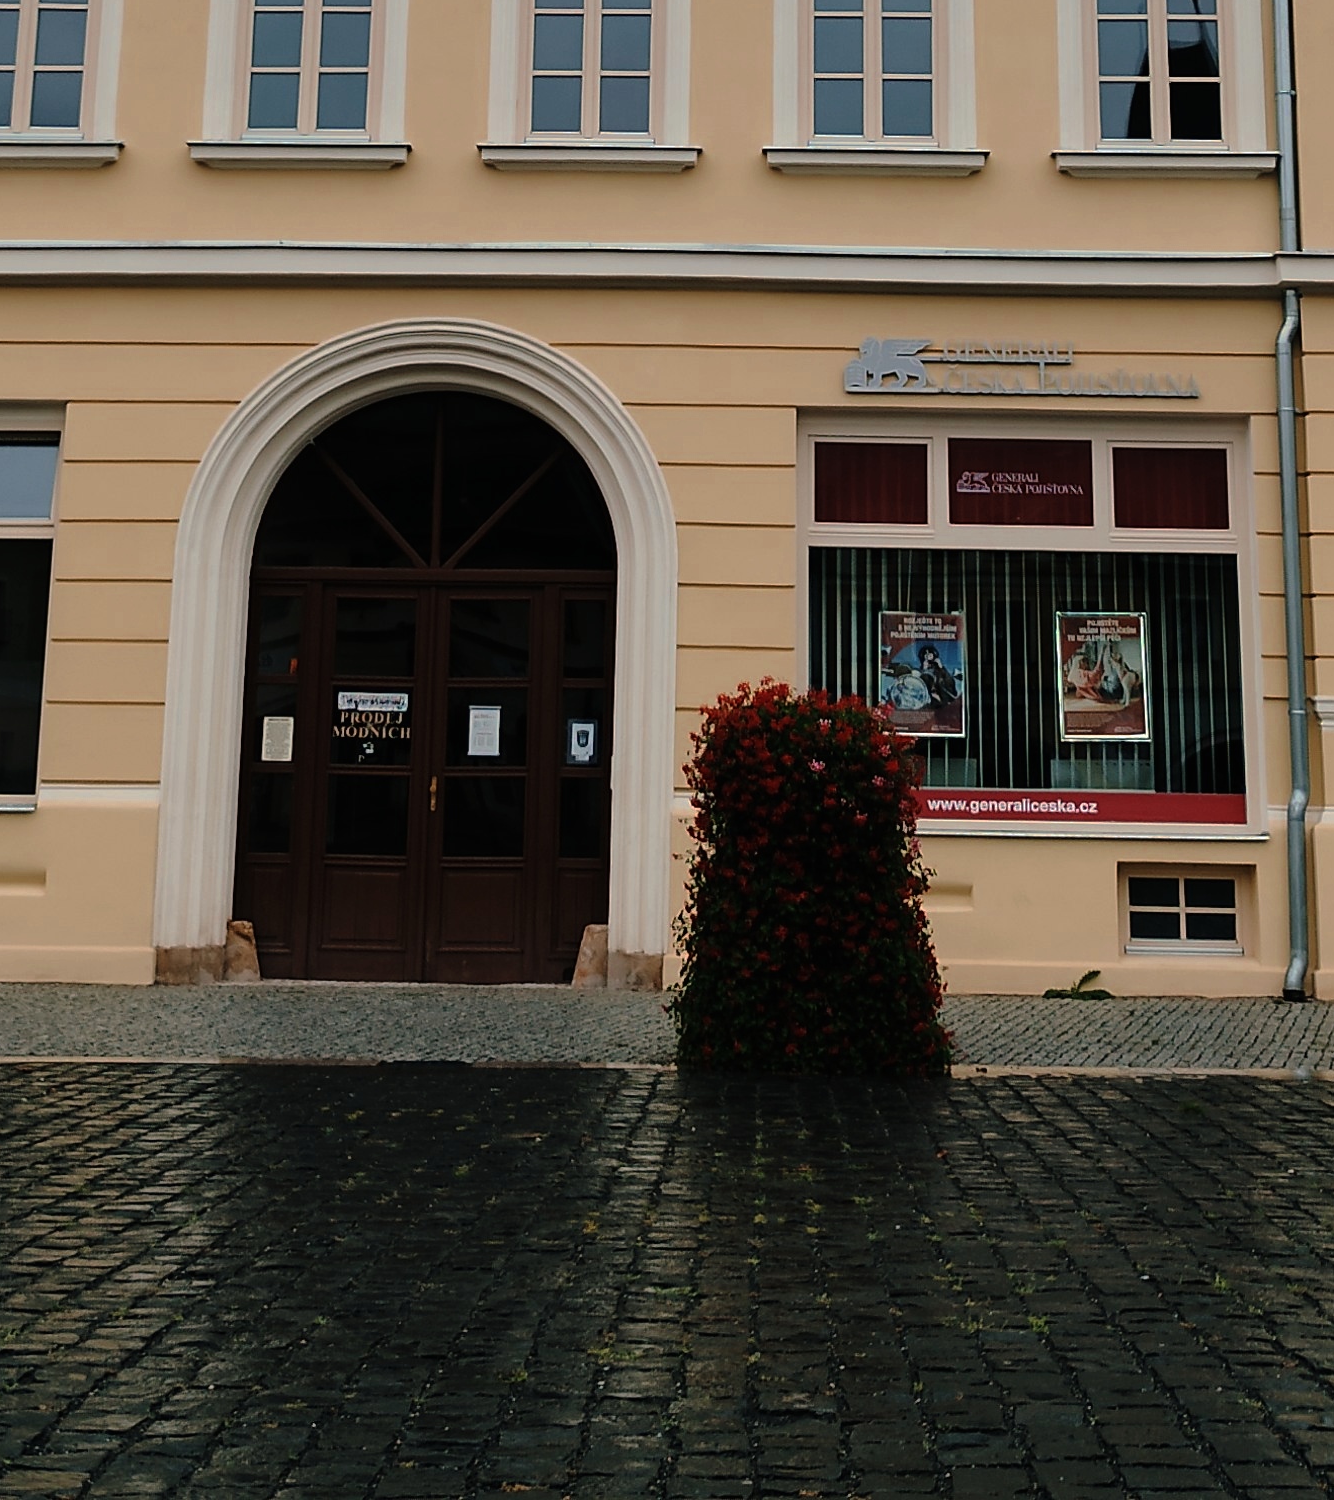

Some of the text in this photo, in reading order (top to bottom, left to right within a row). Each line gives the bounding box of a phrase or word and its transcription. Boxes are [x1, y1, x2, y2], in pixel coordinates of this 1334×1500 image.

[942, 340, 1074, 362] GENERALI
[1040, 368, 1200, 397] POJIŠŤOVNA
[991, 472, 1039, 483] GENERALI
[991, 482, 1084, 495] ČESKÁ POJIŠŤOVNA
[340, 711, 403, 724] PRODEJ
[927, 798, 1099, 814] www.generaliceska.cz
